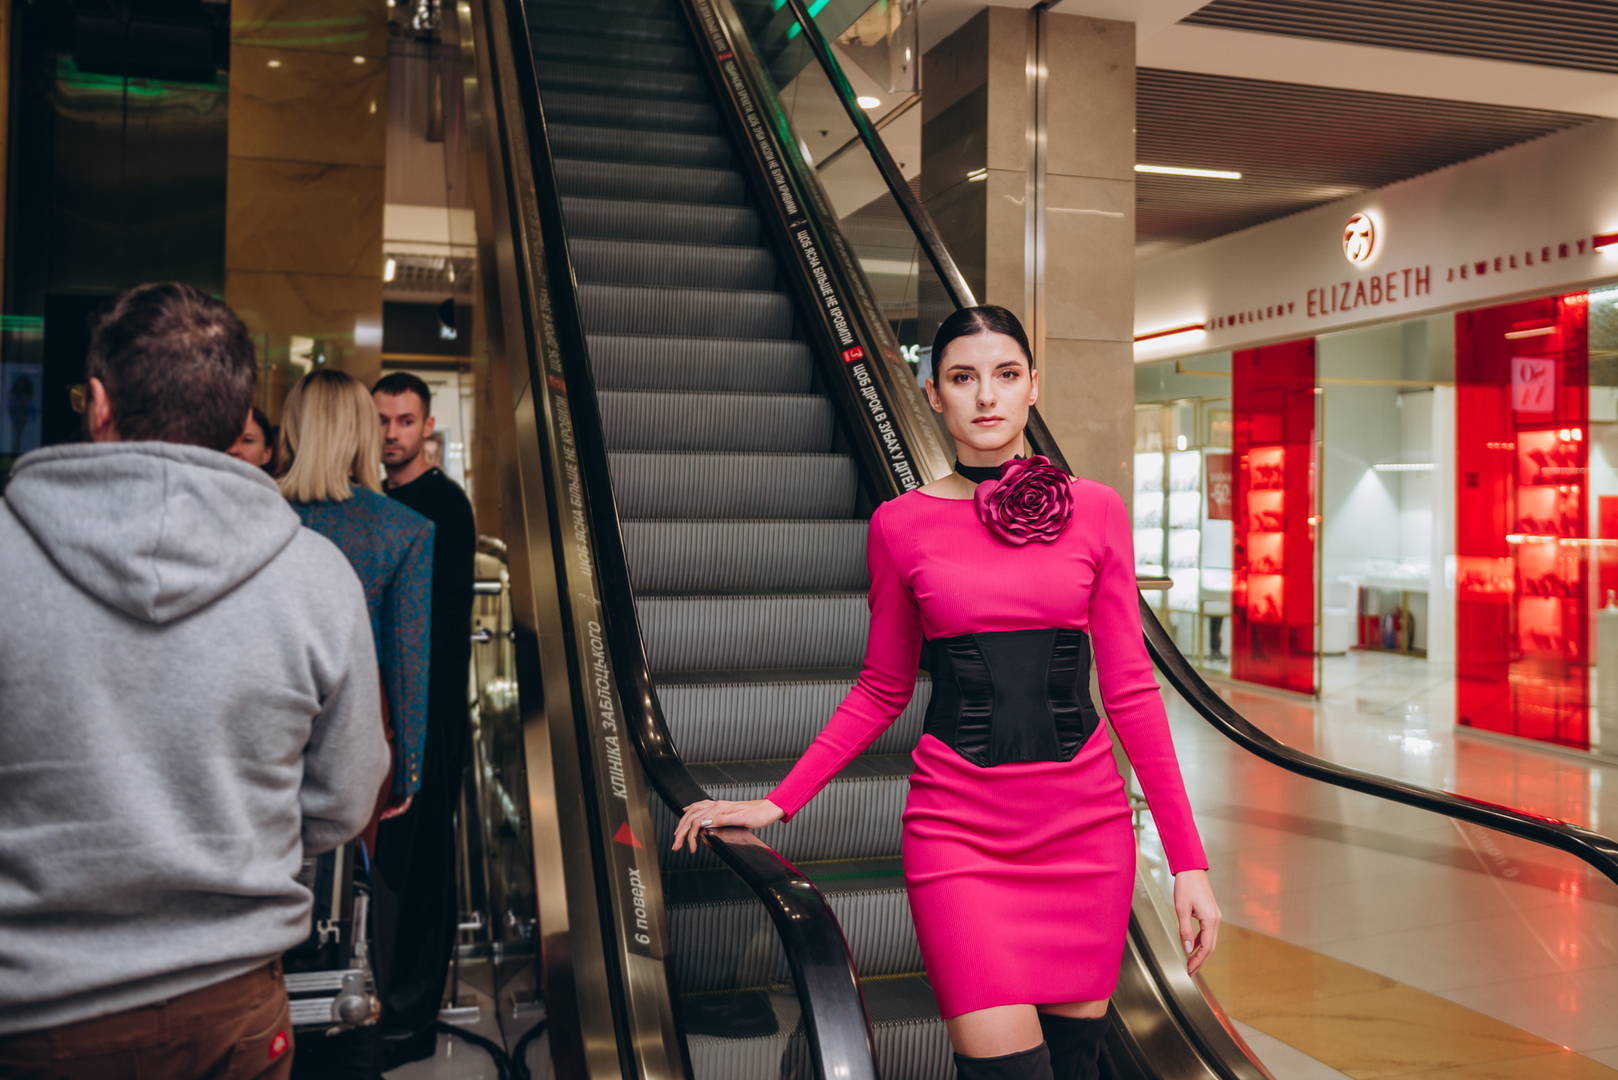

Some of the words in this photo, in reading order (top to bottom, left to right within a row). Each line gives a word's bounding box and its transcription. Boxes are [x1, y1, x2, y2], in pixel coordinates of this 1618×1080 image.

[797, 229, 813, 248] ЩОБ
[804, 245, 820, 268] ЯСНА
[813, 266, 833, 297] БІЛЬШЕ
[1210, 302, 1295, 330] JEWELLERY
[1307, 265, 1430, 318] ELIZABETH
[1446, 238, 1586, 282] JEWELLERY
[824, 294, 838, 309] НЕ
[829, 306, 854, 346] КРОВИЛИ
[852, 363, 872, 387] ЩОБ
[860, 384, 884, 415] ДІРОК
[556, 395, 573, 444] КРОВИЛИ
[874, 413, 887, 423] В
[878, 420, 902, 454] ЗУБАХ
[563, 442, 576, 466] НЕ
[891, 452, 905, 461] У
[565, 462, 582, 508] БІЛЬШЕ
[892, 460, 920, 492] ДІТЕЙ
[574, 510, 588, 543] ЯСНА
[576, 541, 593, 577] ЩОБ
[587, 620, 617, 732] ЗАБЛОЦЬКОГО
[604, 735, 628, 799] КЛІНІКА
[628, 866, 649, 930] поверх
[634, 932, 650, 945] 6
